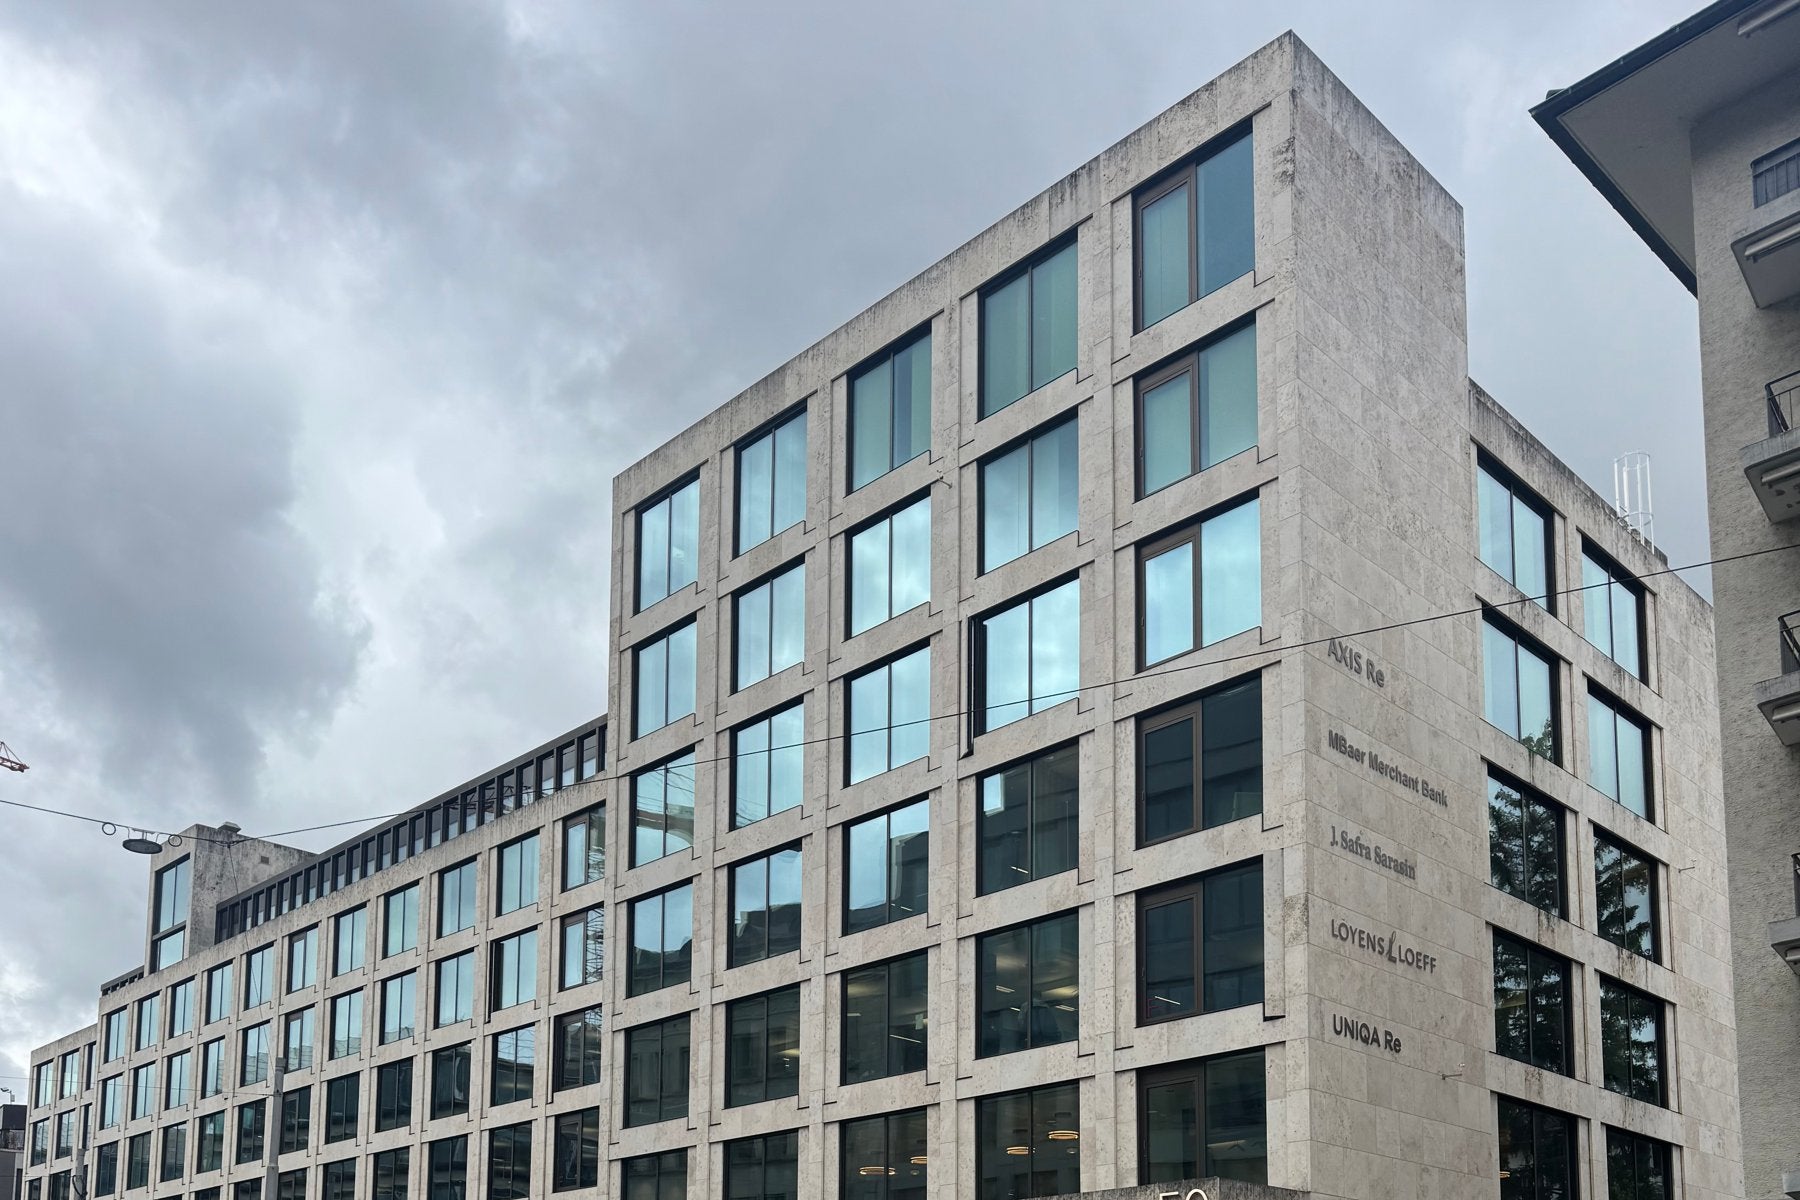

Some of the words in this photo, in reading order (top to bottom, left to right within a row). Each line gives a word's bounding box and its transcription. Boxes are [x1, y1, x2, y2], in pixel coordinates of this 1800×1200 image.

[1328, 639, 1363, 675] AXIS
[1366, 658, 1385, 688] Re
[1328, 729, 1366, 764] MBaer
[1368, 750, 1420, 794] Merchant
[1421, 779, 1448, 808] Bank
[1330, 825, 1339, 847] J.
[1341, 830, 1372, 861] Safra
[1374, 845, 1416, 880] Sarasin
[1332, 1013, 1381, 1048] UNIQA
[1384, 1029, 1402, 1054] Re
